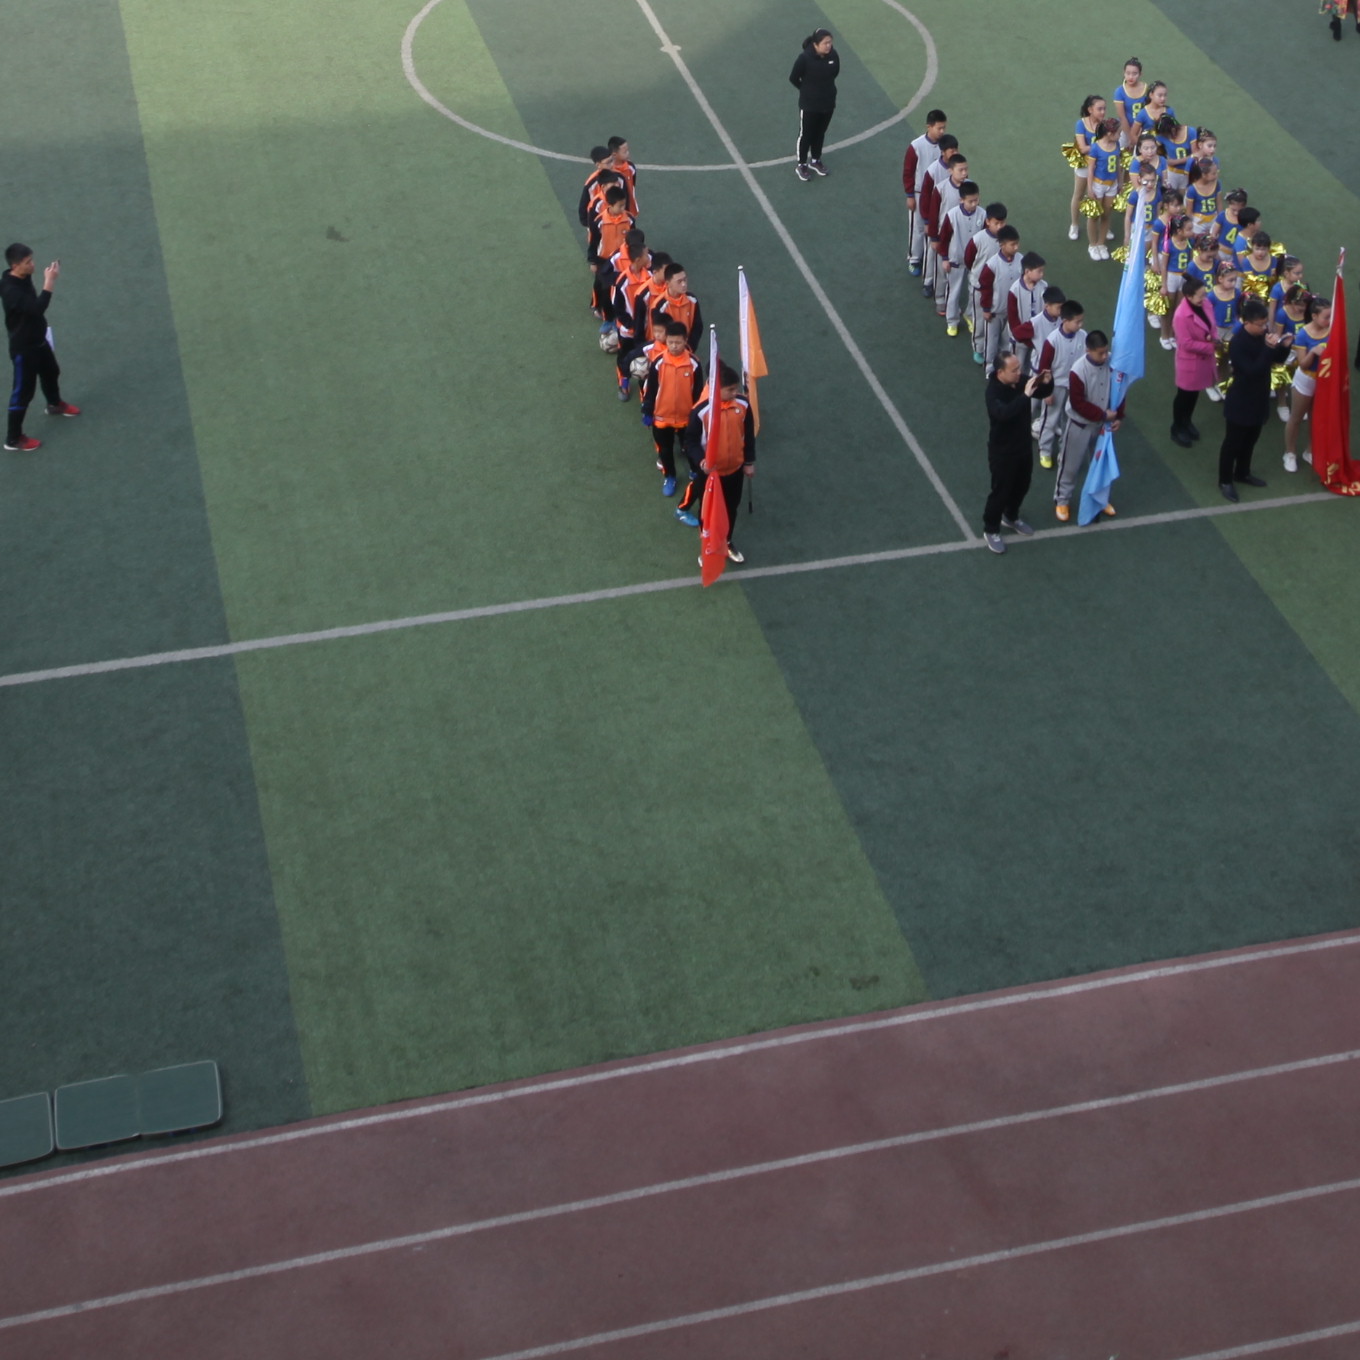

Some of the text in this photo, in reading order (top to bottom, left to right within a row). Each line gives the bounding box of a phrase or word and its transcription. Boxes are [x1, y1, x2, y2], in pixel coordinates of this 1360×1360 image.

[1107, 154, 1118, 173] 8
[1200, 197, 1216, 213] 15
[1225, 227, 1238, 244] 4
